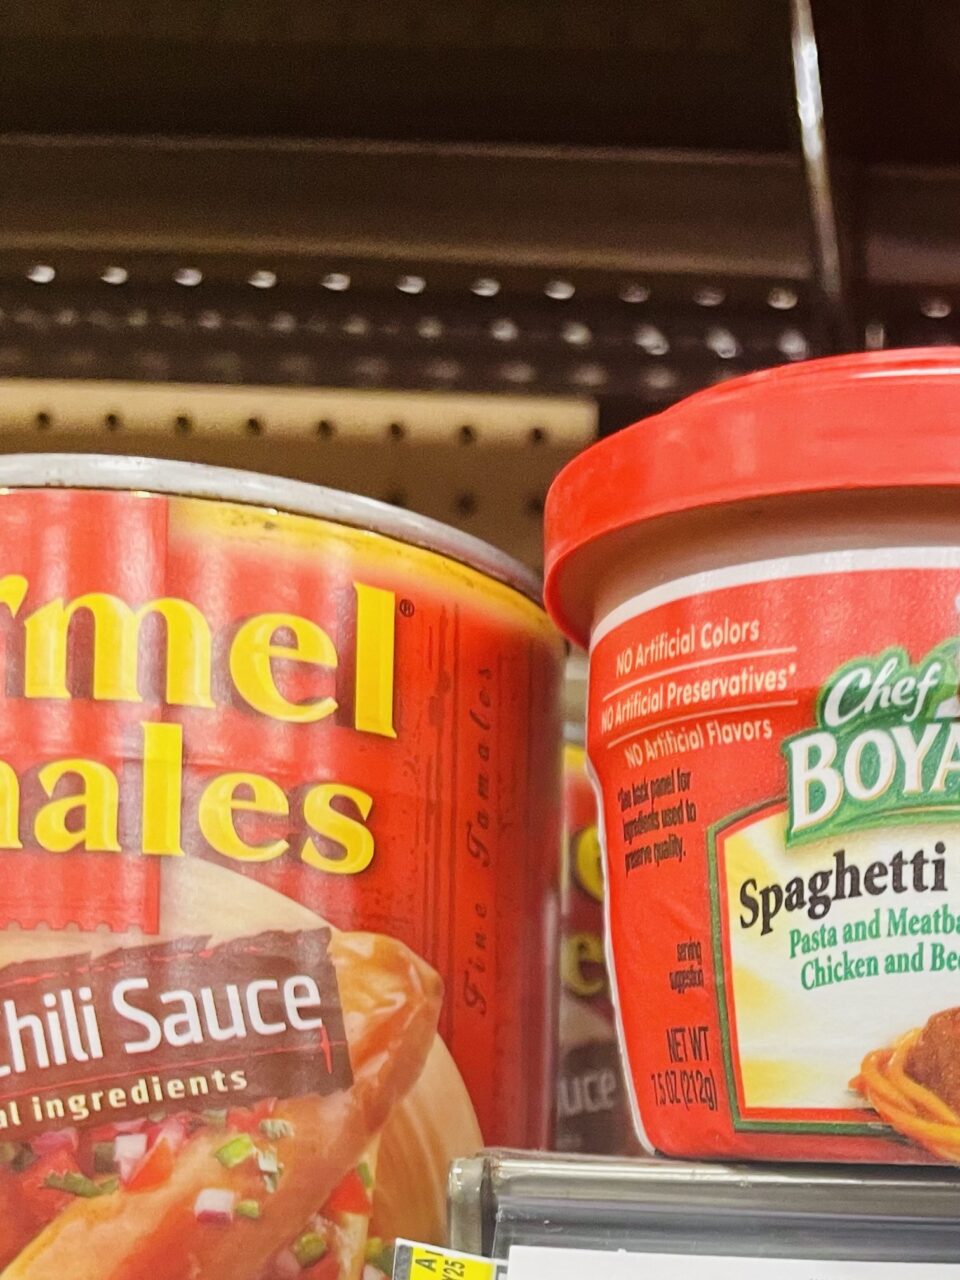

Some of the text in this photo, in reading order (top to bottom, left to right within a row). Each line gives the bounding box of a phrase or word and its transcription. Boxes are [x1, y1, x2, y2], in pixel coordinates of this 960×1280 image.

[616, 616, 760, 678] NO Artificial Colors
[615, 684, 663, 726] Artificial
[824, 656, 942, 726] Chef
[624, 719, 772, 768] NO Artificial Flavors
[463, 668, 492, 1015] Fine Tamales
[739, 842, 948, 936] Spaghetti
[789, 924, 837, 959] Pasta
[843, 908, 881, 943] and
[800, 952, 879, 990] Chicken
[884, 942, 924, 973] and
[112, 975, 323, 1054] Sauce
[666, 1026, 710, 1063] NET WT
[32, 1070, 248, 1121] ingredients
